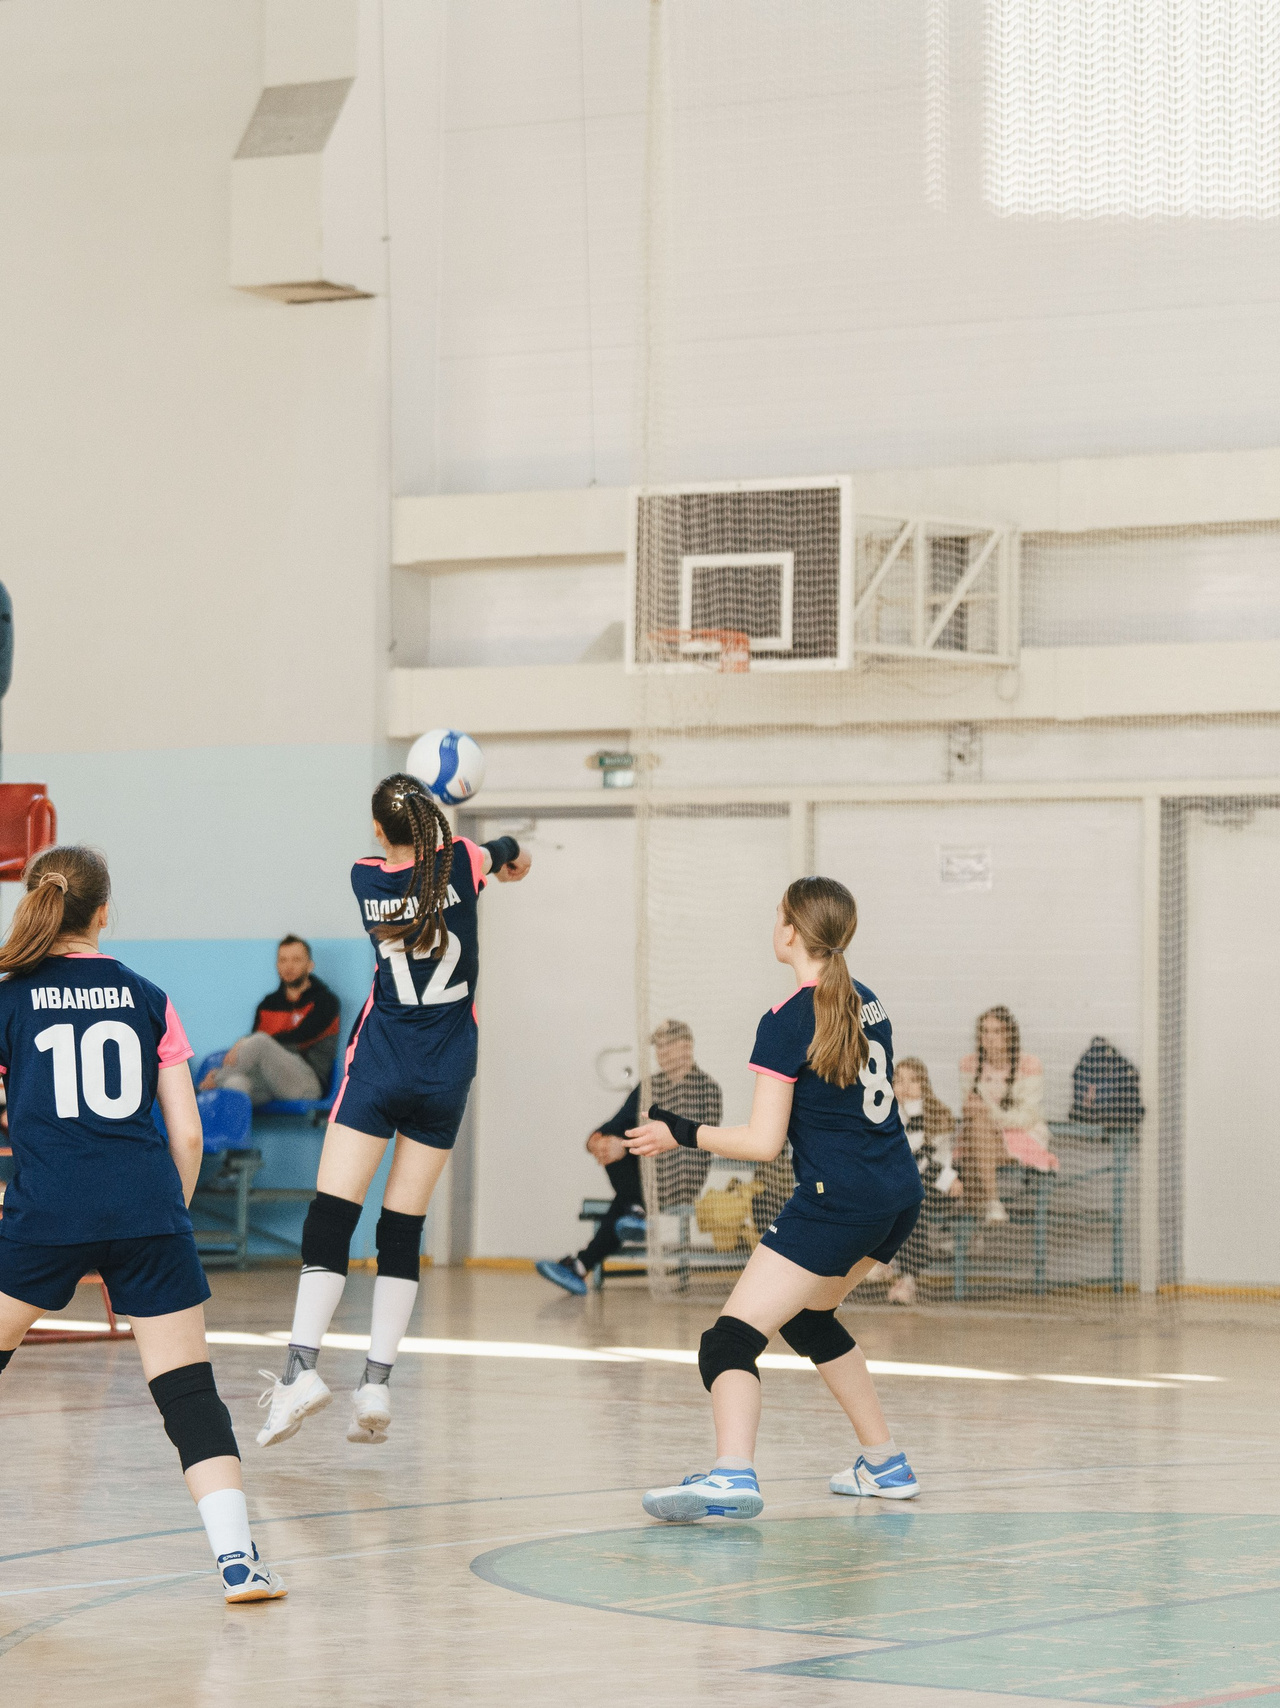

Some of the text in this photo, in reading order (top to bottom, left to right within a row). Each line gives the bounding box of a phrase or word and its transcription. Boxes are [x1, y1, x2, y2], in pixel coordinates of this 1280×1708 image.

[31, 986, 135, 1010] ИВАНОВА
[378, 929, 469, 1005] 12
[34, 1020, 142, 1119] 10
[858, 1040, 895, 1124] 8
